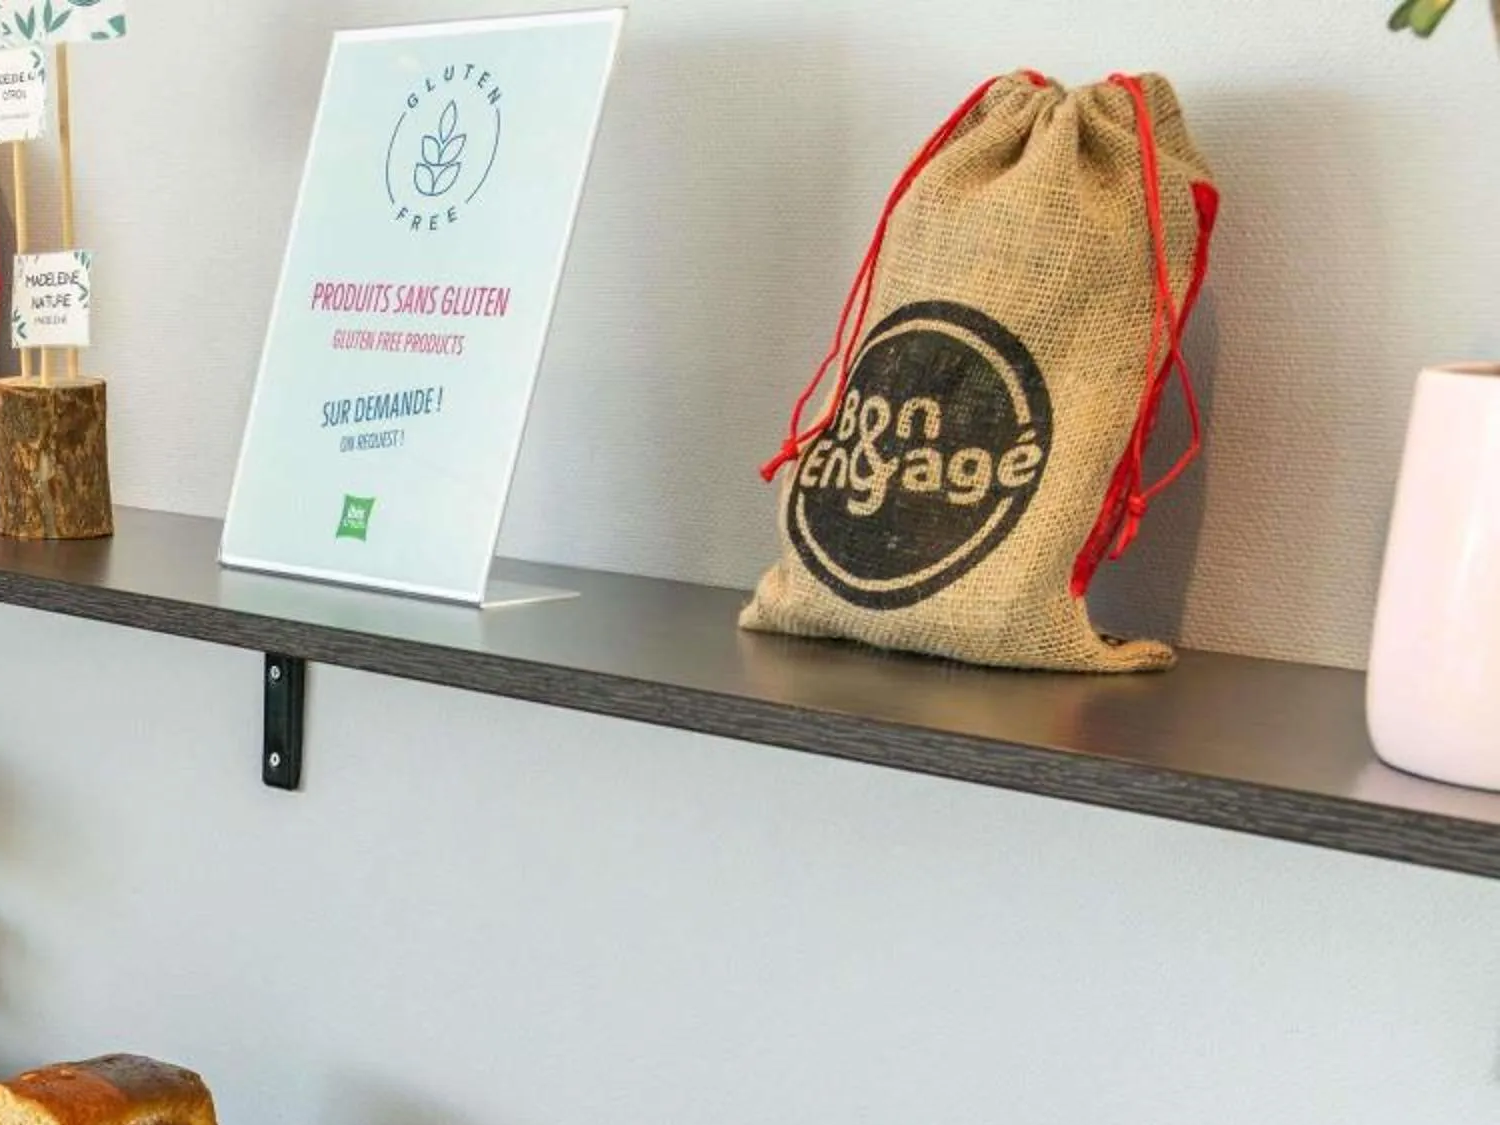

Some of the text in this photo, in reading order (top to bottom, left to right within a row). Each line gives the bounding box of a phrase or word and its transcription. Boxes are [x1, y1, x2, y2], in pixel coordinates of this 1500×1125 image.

[407, 63, 503, 108] GLUTEN
[396, 206, 459, 232] FREE
[26, 271, 79, 287] MADELEINE
[31, 293, 73, 309] NATURE
[311, 282, 511, 317] PRODUITS SANS GLUTEN
[332, 329, 466, 356] GLUTEN FREE PRODUCTS
[321, 385, 443, 428] SUR DEMANDE !
[838, 390, 941, 441] Bon
[340, 435, 354, 453] ON
[357, 429, 398, 451] REQUEST
[800, 429, 1043, 516] Engagé
